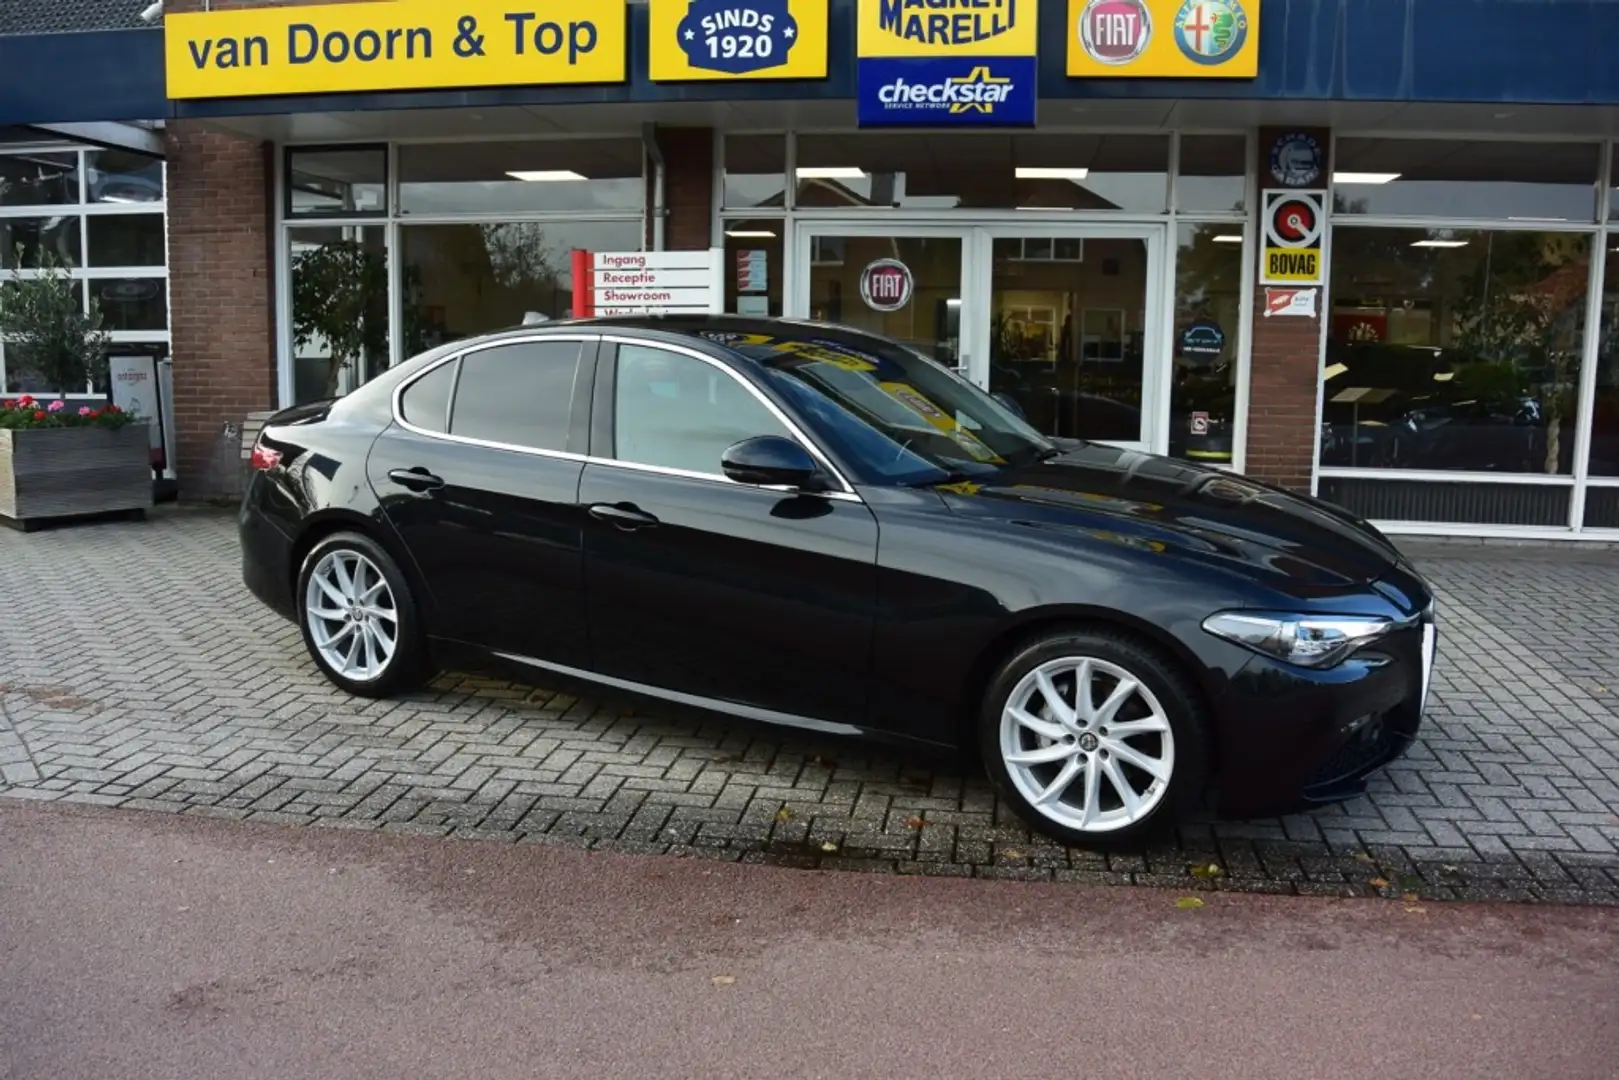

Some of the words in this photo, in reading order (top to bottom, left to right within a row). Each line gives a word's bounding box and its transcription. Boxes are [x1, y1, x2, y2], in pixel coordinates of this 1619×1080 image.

[701, 8, 775, 35] SINDS
[879, 12, 1016, 45] MARELLI
[1095, 14, 1137, 46] FIAT
[188, 35, 269, 69] van
[287, 23, 433, 64] Doorn
[452, 15, 486, 57] &
[504, 12, 598, 65] Top
[705, 35, 773, 58] 1920
[878, 78, 1014, 103] checkstar
[603, 255, 646, 267] Ingang
[1270, 253, 1316, 275] BOVAG
[603, 272, 656, 284] Receptie
[872, 274, 902, 297] FIAT
[604, 291, 671, 301] Showroom
